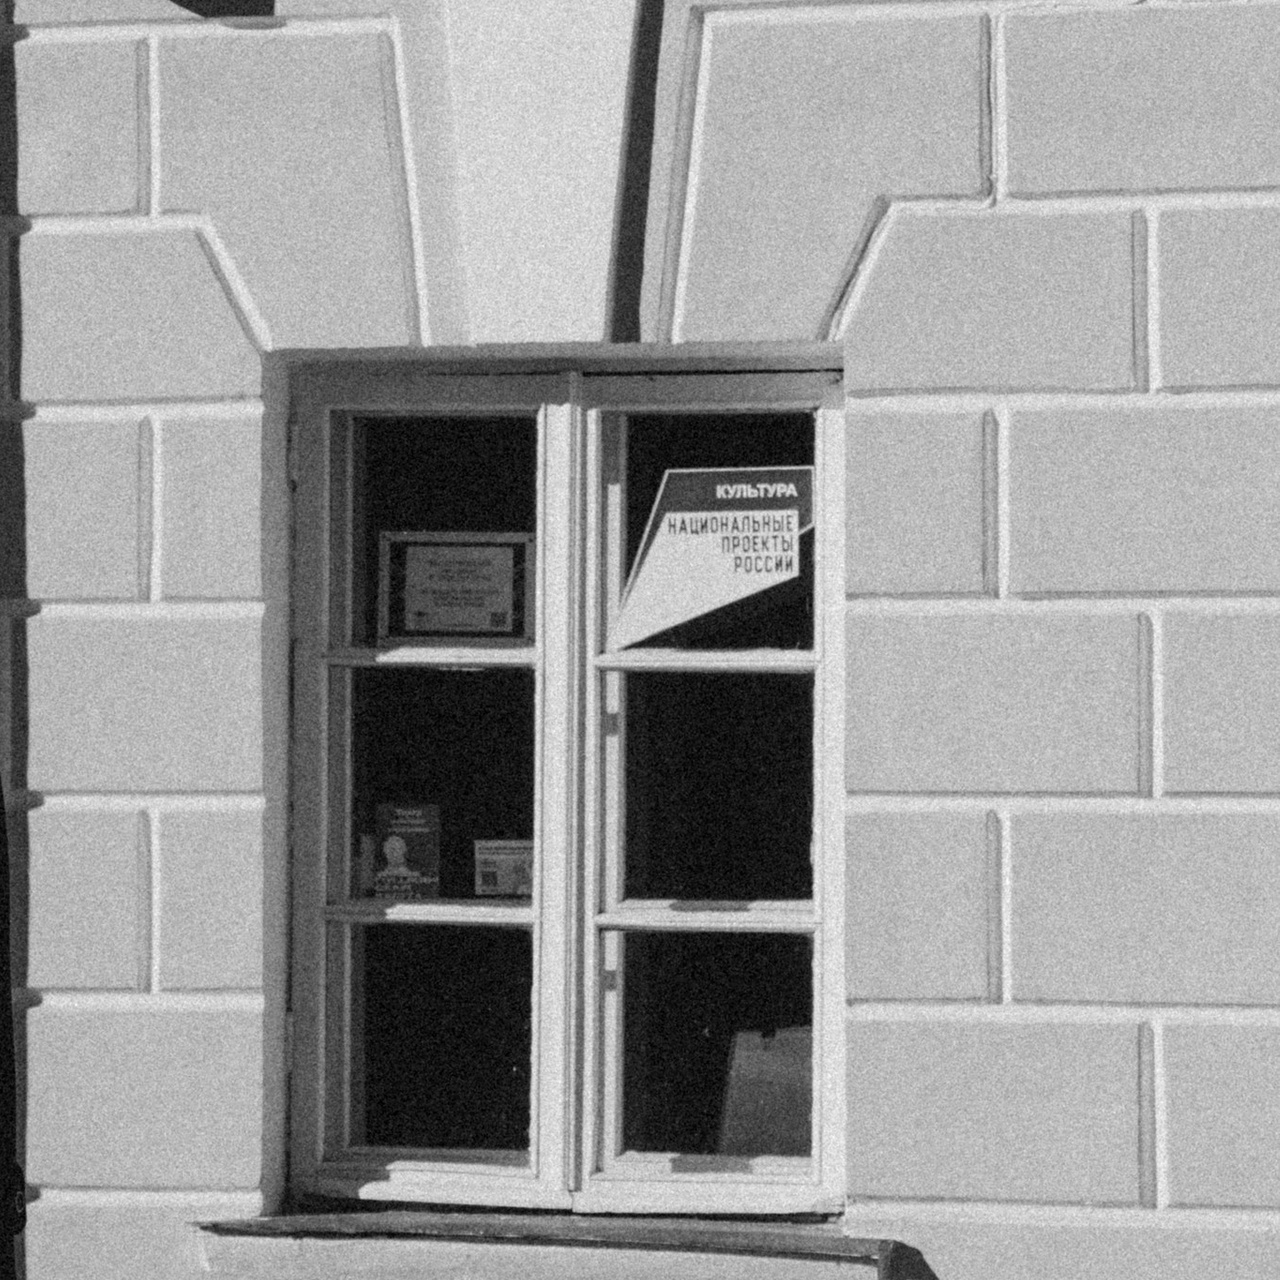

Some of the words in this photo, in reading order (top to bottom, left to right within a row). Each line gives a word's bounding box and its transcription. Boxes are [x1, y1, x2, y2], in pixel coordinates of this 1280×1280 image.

[716, 483, 799, 500] КУЛЬТУРА
[668, 515, 795, 535] НАЦИОНАЛЬНЫЕ
[721, 535, 795, 554] ПРОЕКТЫ
[734, 555, 795, 574] РОССИИ
